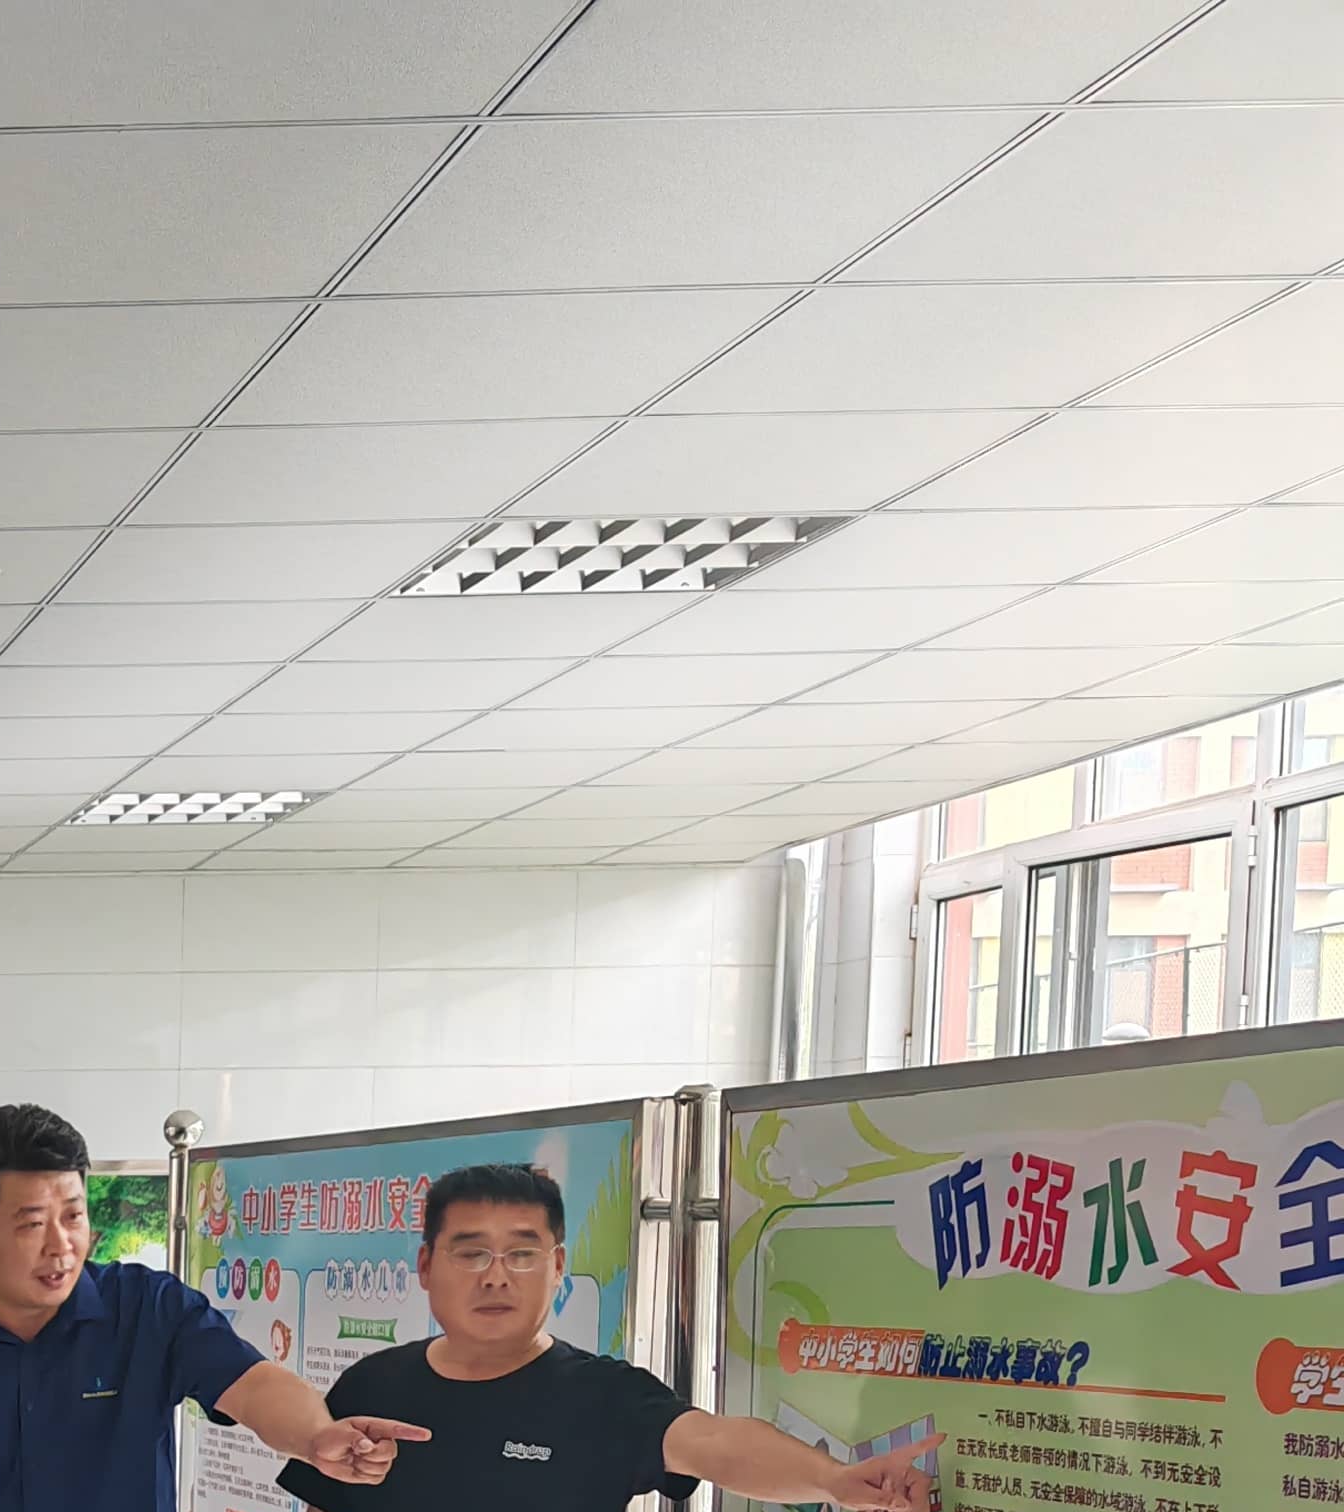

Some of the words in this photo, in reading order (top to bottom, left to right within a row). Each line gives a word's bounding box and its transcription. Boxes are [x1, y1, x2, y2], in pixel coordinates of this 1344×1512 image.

[242, 1173, 432, 1235] 中小学生防溺水安全
[928, 1141, 1344, 1291] 防溺水安全
